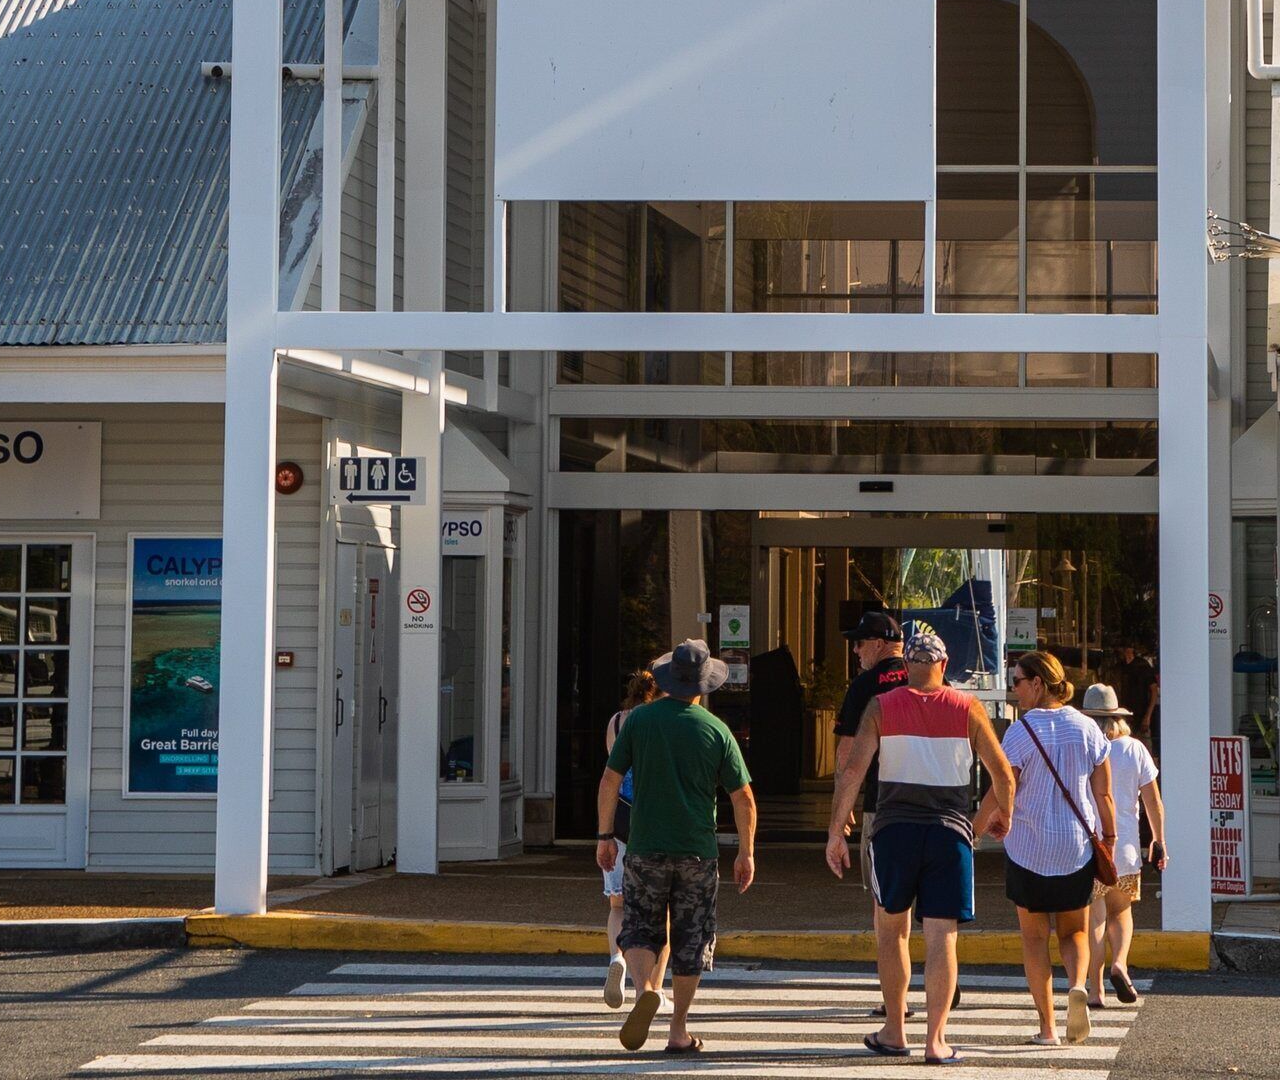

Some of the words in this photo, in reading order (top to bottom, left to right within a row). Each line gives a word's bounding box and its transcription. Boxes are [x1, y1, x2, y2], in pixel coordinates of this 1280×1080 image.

[441, 520, 483, 537] YPSO
[146, 554, 223, 576] CALYP
[165, 577, 198, 586] snorkel
[199, 577, 218, 586] and
[181, 729, 199, 738] Full
[201, 729, 218, 739] day
[141, 739, 177, 750] Great
[181, 739, 219, 750] Barrie
[1211, 741, 1242, 775] KETS
[1211, 775, 1229, 791] ERY
[1211, 792, 1242, 809] ESDAY
[1211, 827, 1242, 842] ALBROOK
[1211, 842, 1238, 856] RYACHT
[1211, 856, 1241, 878] RINA
